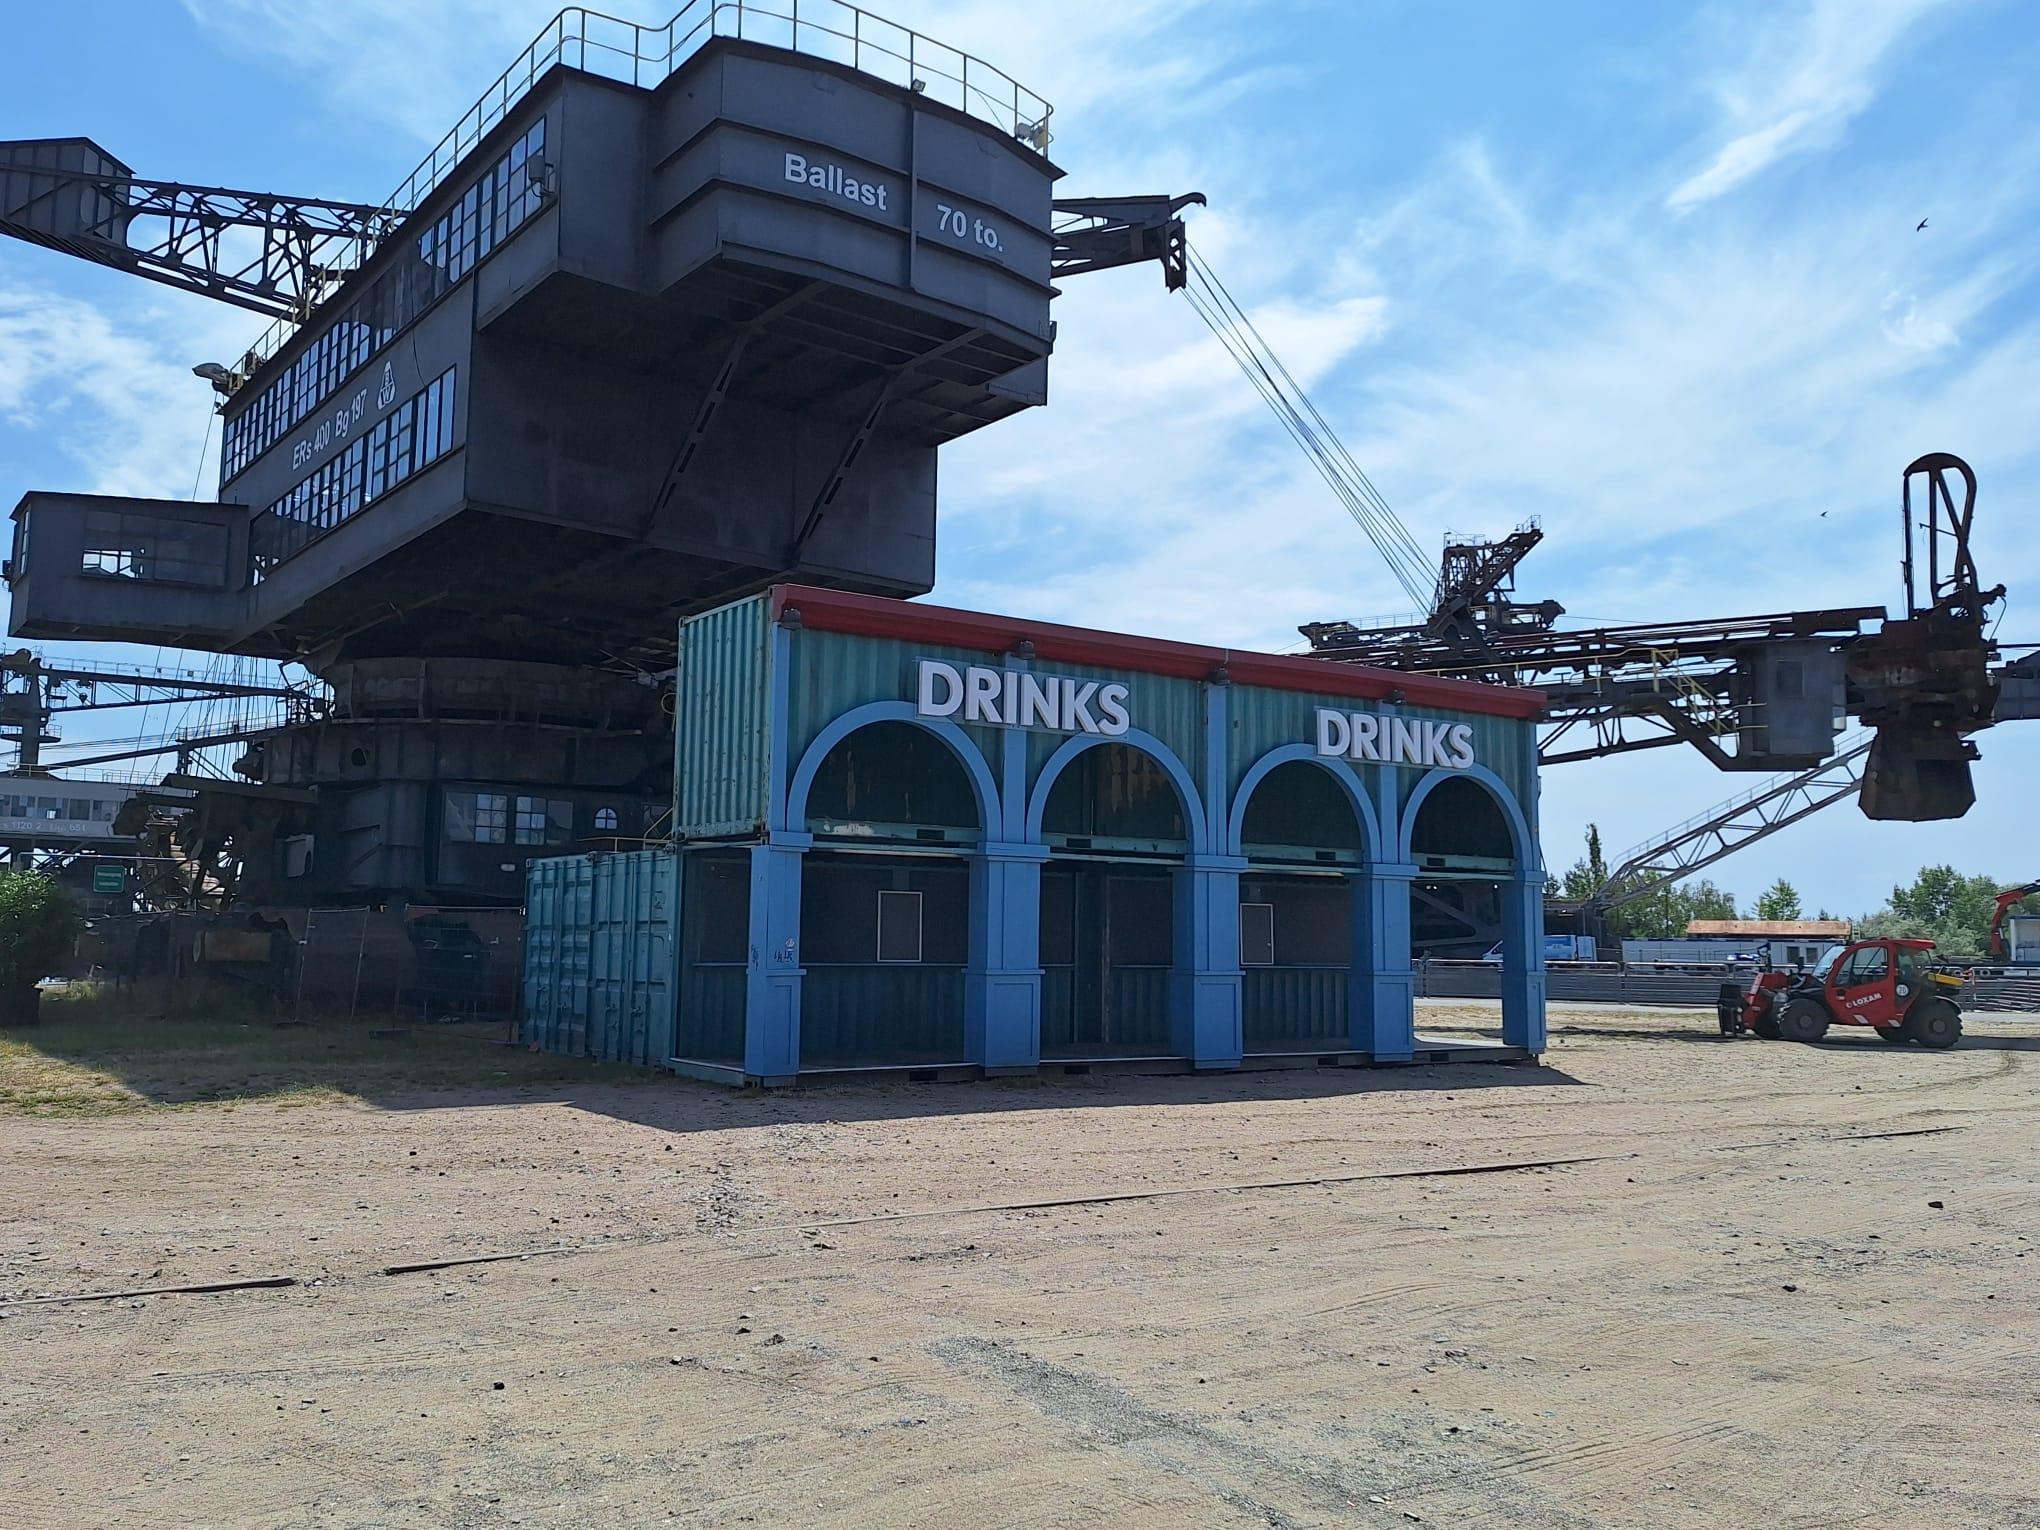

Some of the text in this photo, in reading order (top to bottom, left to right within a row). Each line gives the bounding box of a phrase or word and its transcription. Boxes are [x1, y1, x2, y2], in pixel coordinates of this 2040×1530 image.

[784, 152, 1003, 252] Ballast 70 to.
[292, 388, 368, 471] ERs 400 Bg 197
[918, 660, 1130, 736] DRINKS
[1316, 708, 1475, 769] DRINKS
[1852, 993, 1882, 1006] LOXAM
